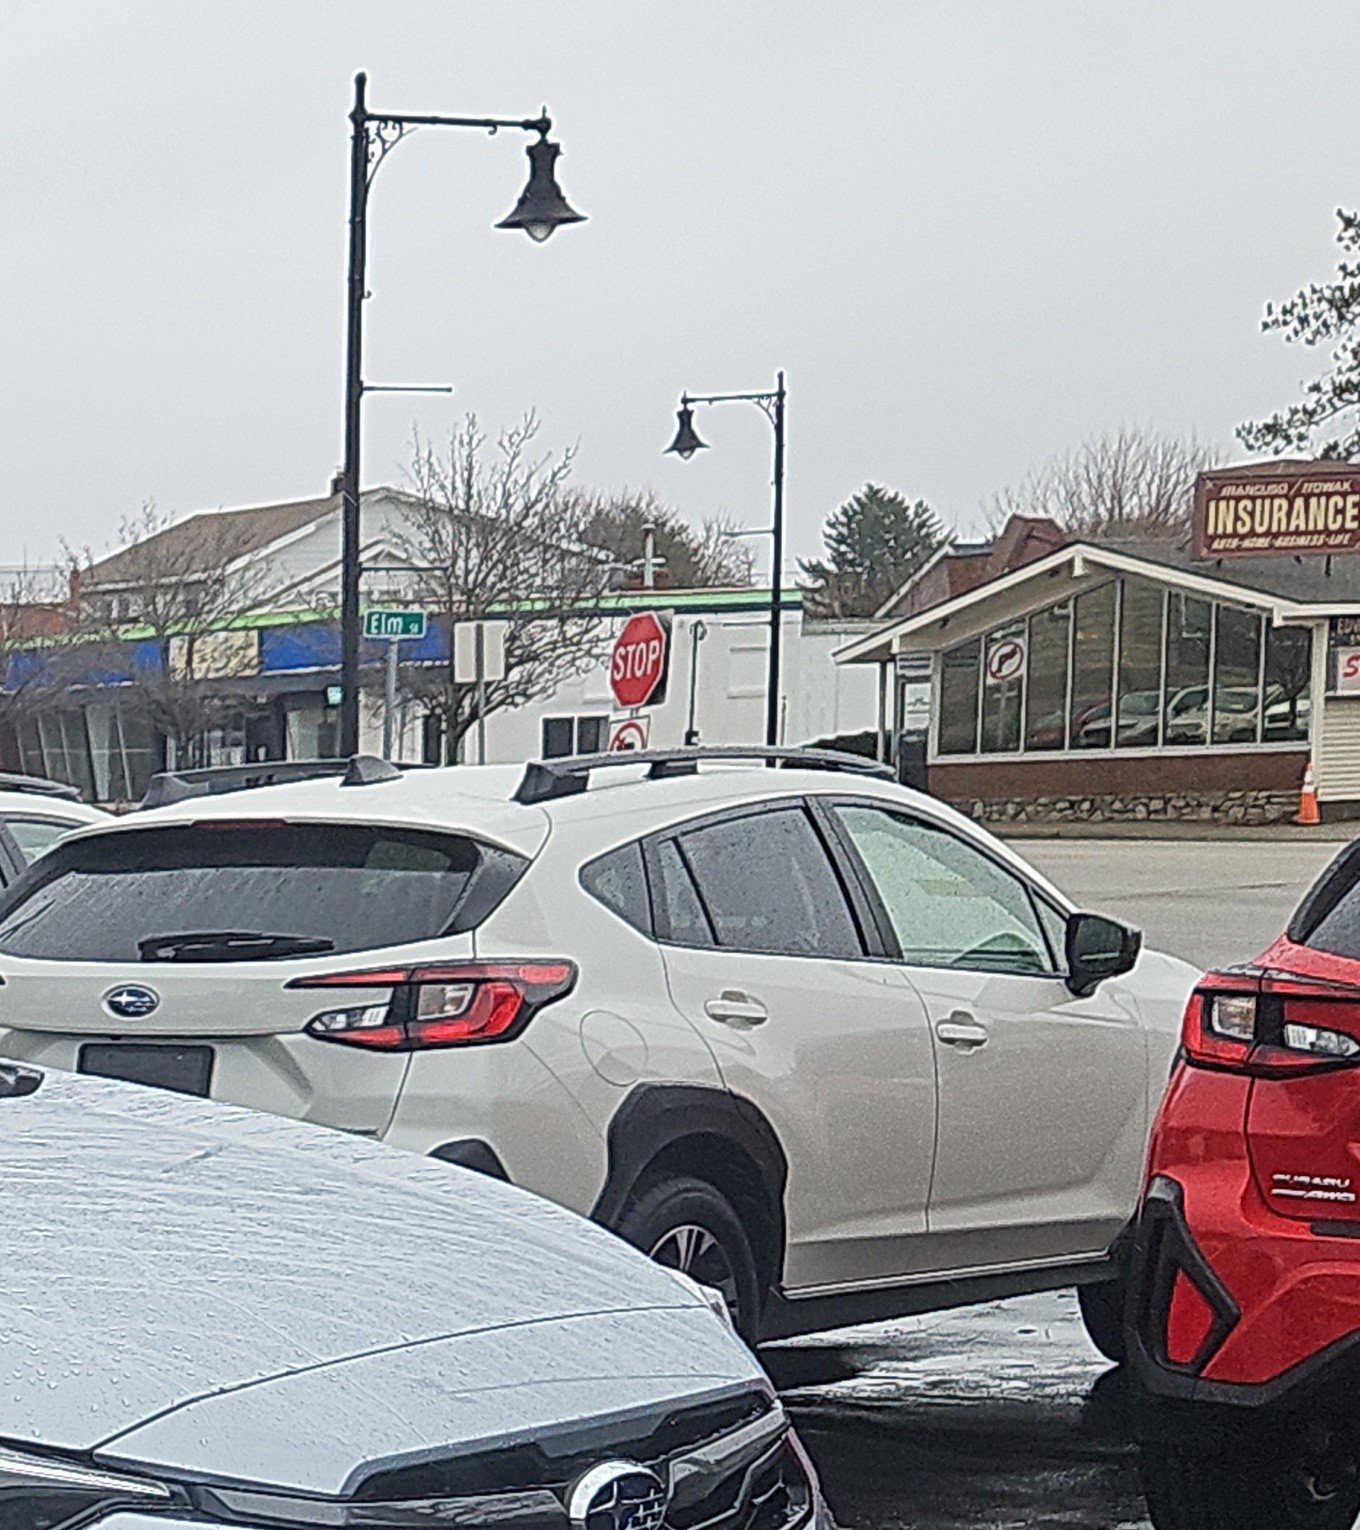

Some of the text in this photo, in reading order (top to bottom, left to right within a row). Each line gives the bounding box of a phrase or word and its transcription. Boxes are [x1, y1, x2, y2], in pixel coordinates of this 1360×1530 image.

[1207, 494, 1360, 536] INSURANCE
[370, 613, 403, 634] Elm
[613, 639, 660, 681] STOP
